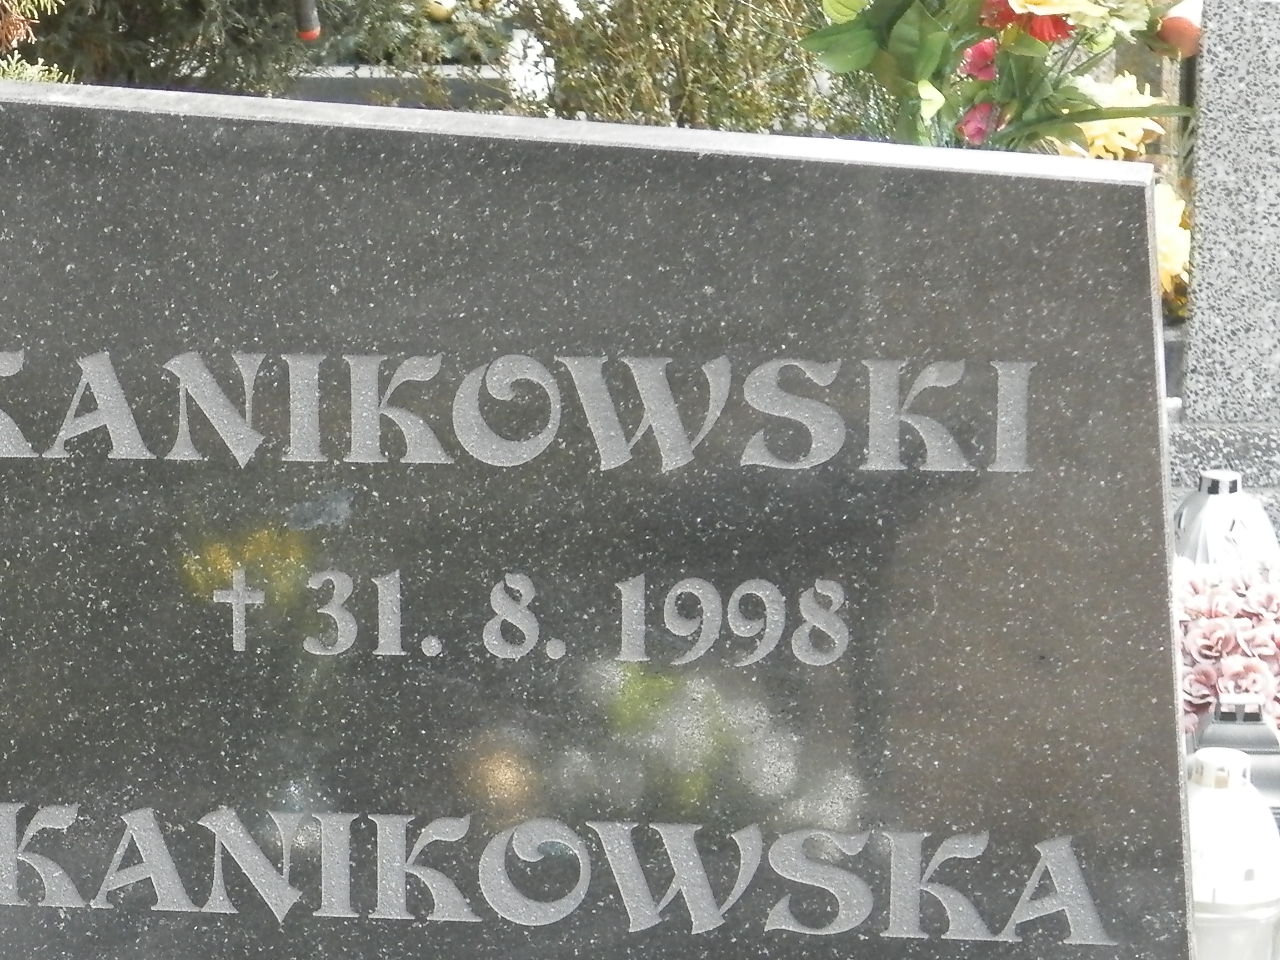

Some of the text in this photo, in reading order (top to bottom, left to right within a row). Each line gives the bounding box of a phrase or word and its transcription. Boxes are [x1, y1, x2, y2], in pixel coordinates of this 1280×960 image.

[302, 571, 443, 659] 31.
[483, 572, 568, 662] 8.
[614, 573, 851, 668] 1998
